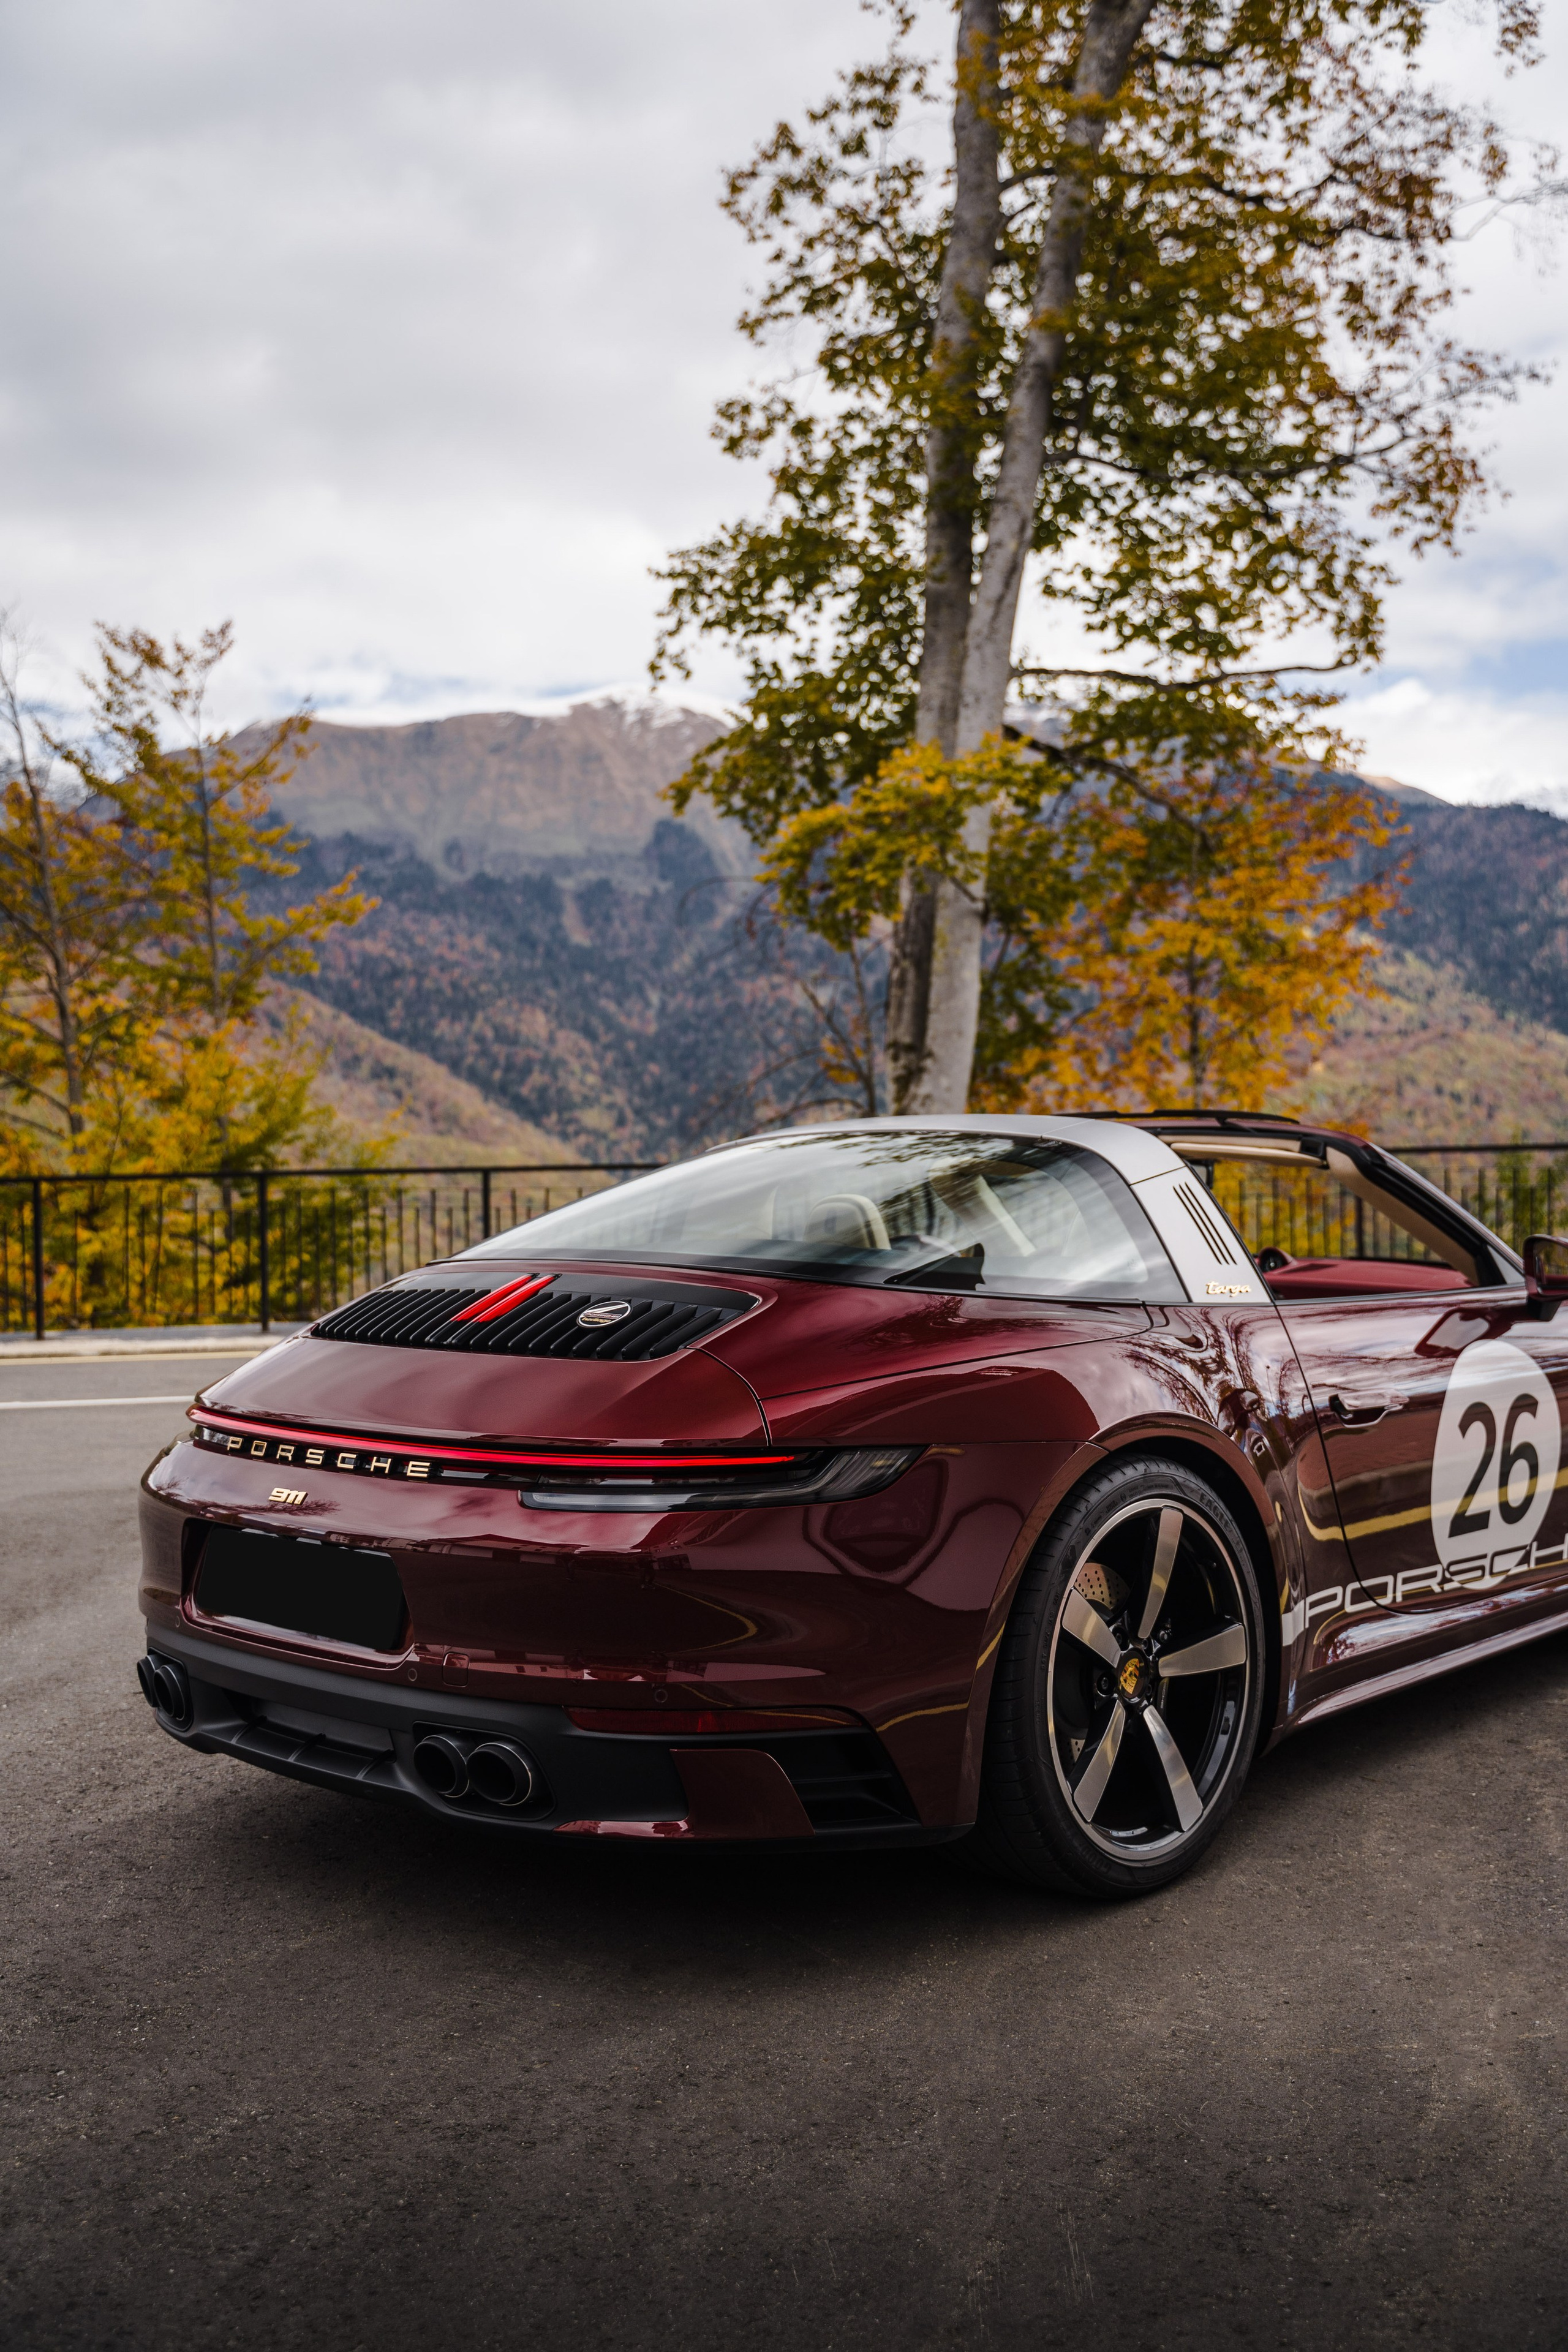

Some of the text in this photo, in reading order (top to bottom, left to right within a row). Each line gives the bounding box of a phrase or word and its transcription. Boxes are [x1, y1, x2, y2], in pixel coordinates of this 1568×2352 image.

[1206, 1281, 1251, 1297] targa
[227, 1436, 430, 1477] PORSCHE
[1448, 1393, 1539, 1539] 26
[268, 1487, 308, 1505] 911
[1200, 1493, 1232, 1529] EAGLE
